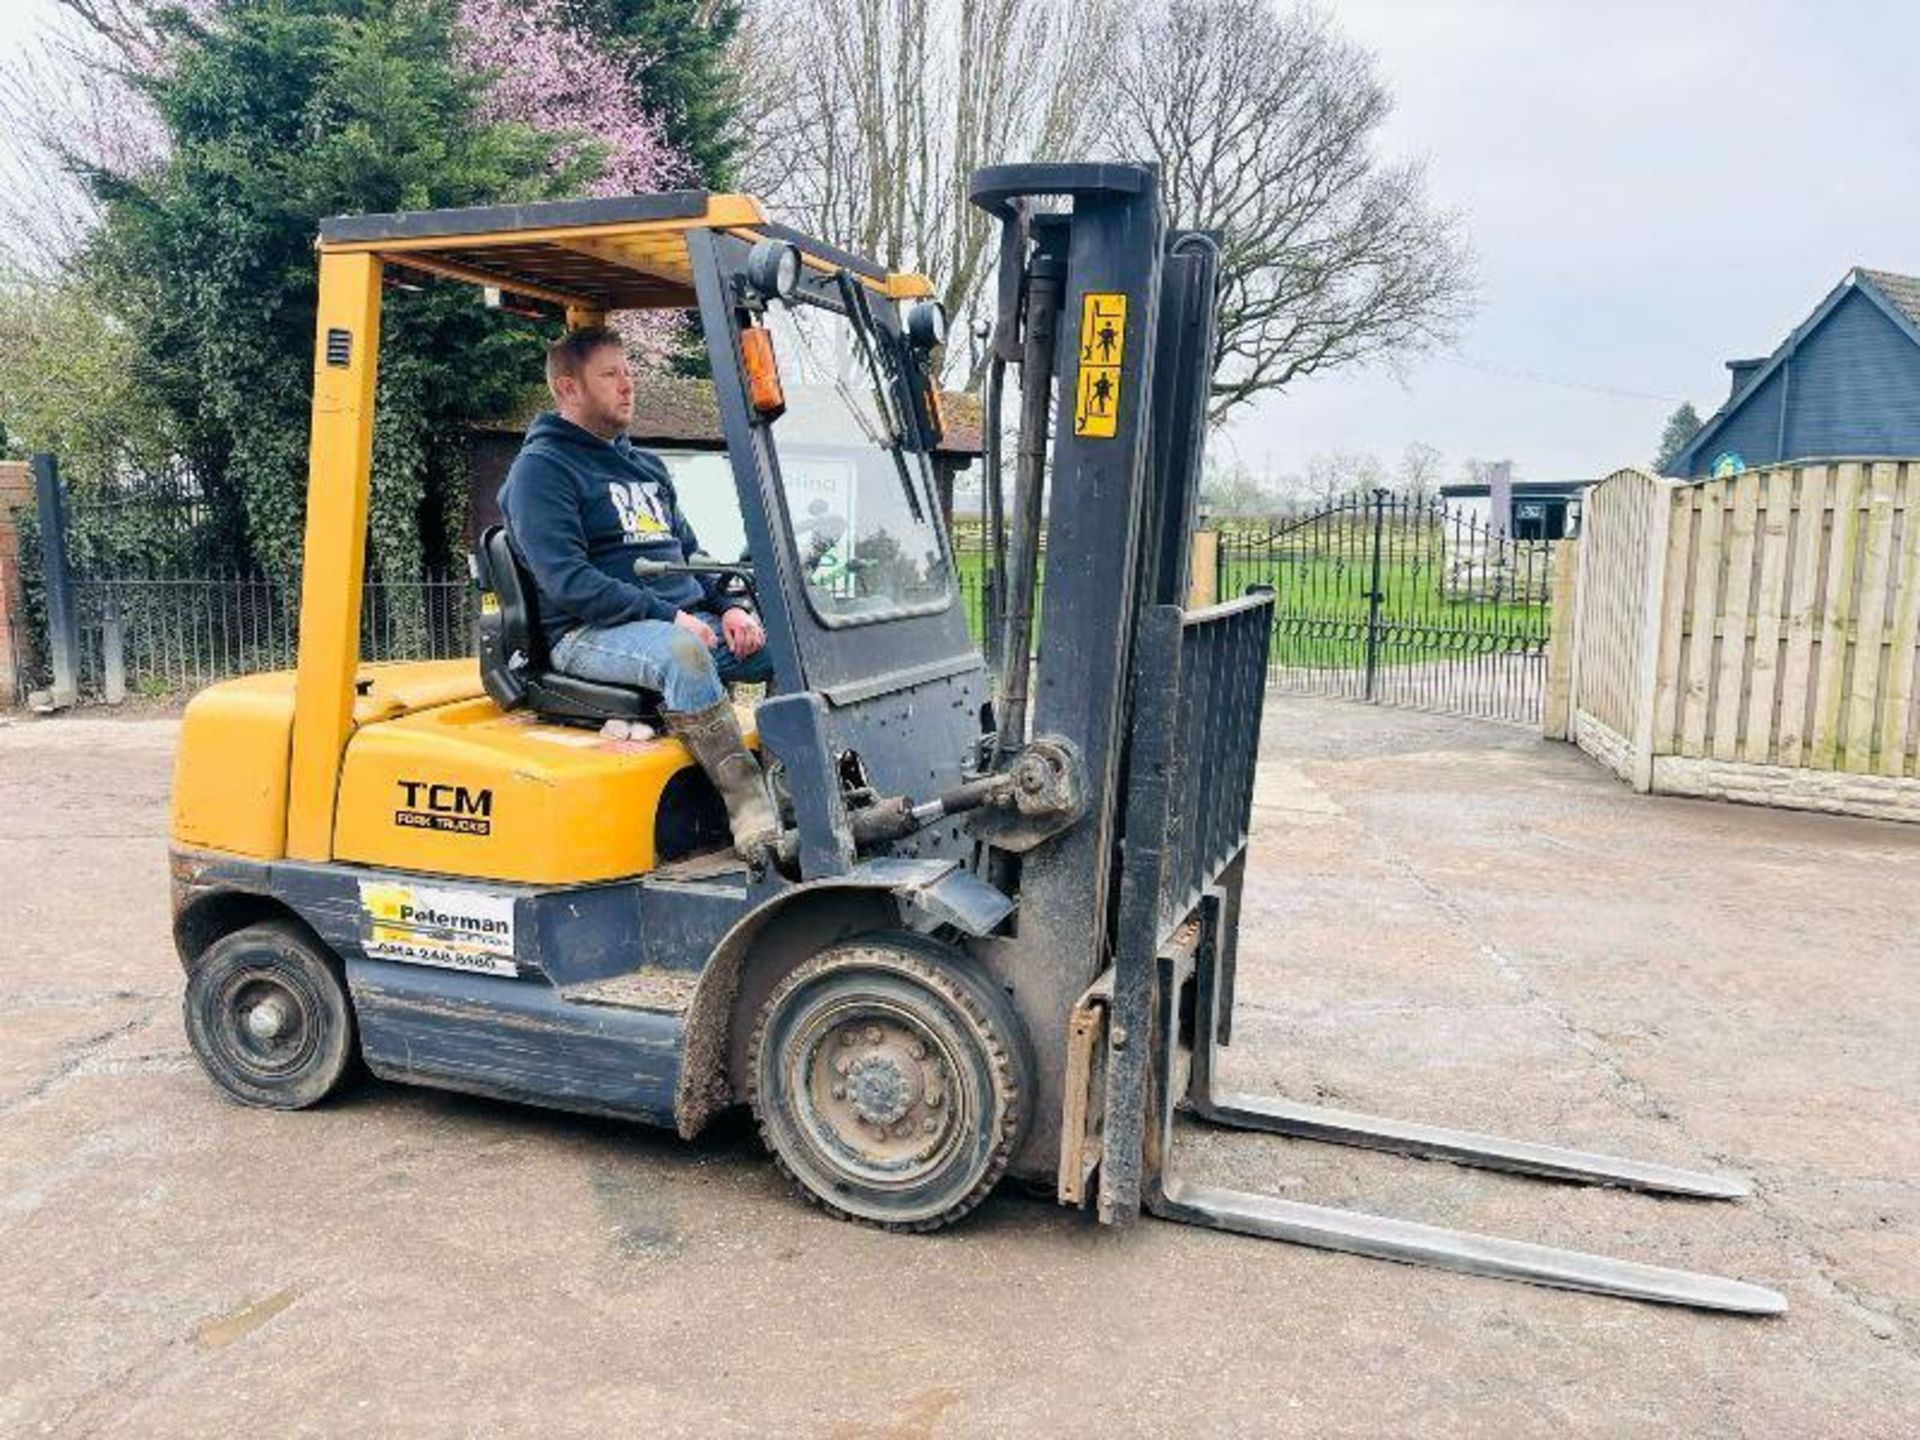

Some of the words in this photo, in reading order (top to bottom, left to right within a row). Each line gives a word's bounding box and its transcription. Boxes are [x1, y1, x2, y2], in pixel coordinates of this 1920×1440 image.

[397, 779, 493, 817] TCM
[397, 812, 431, 827] FORK
[436, 817, 488, 834] TRUCKS
[400, 904, 510, 935] Peterman
